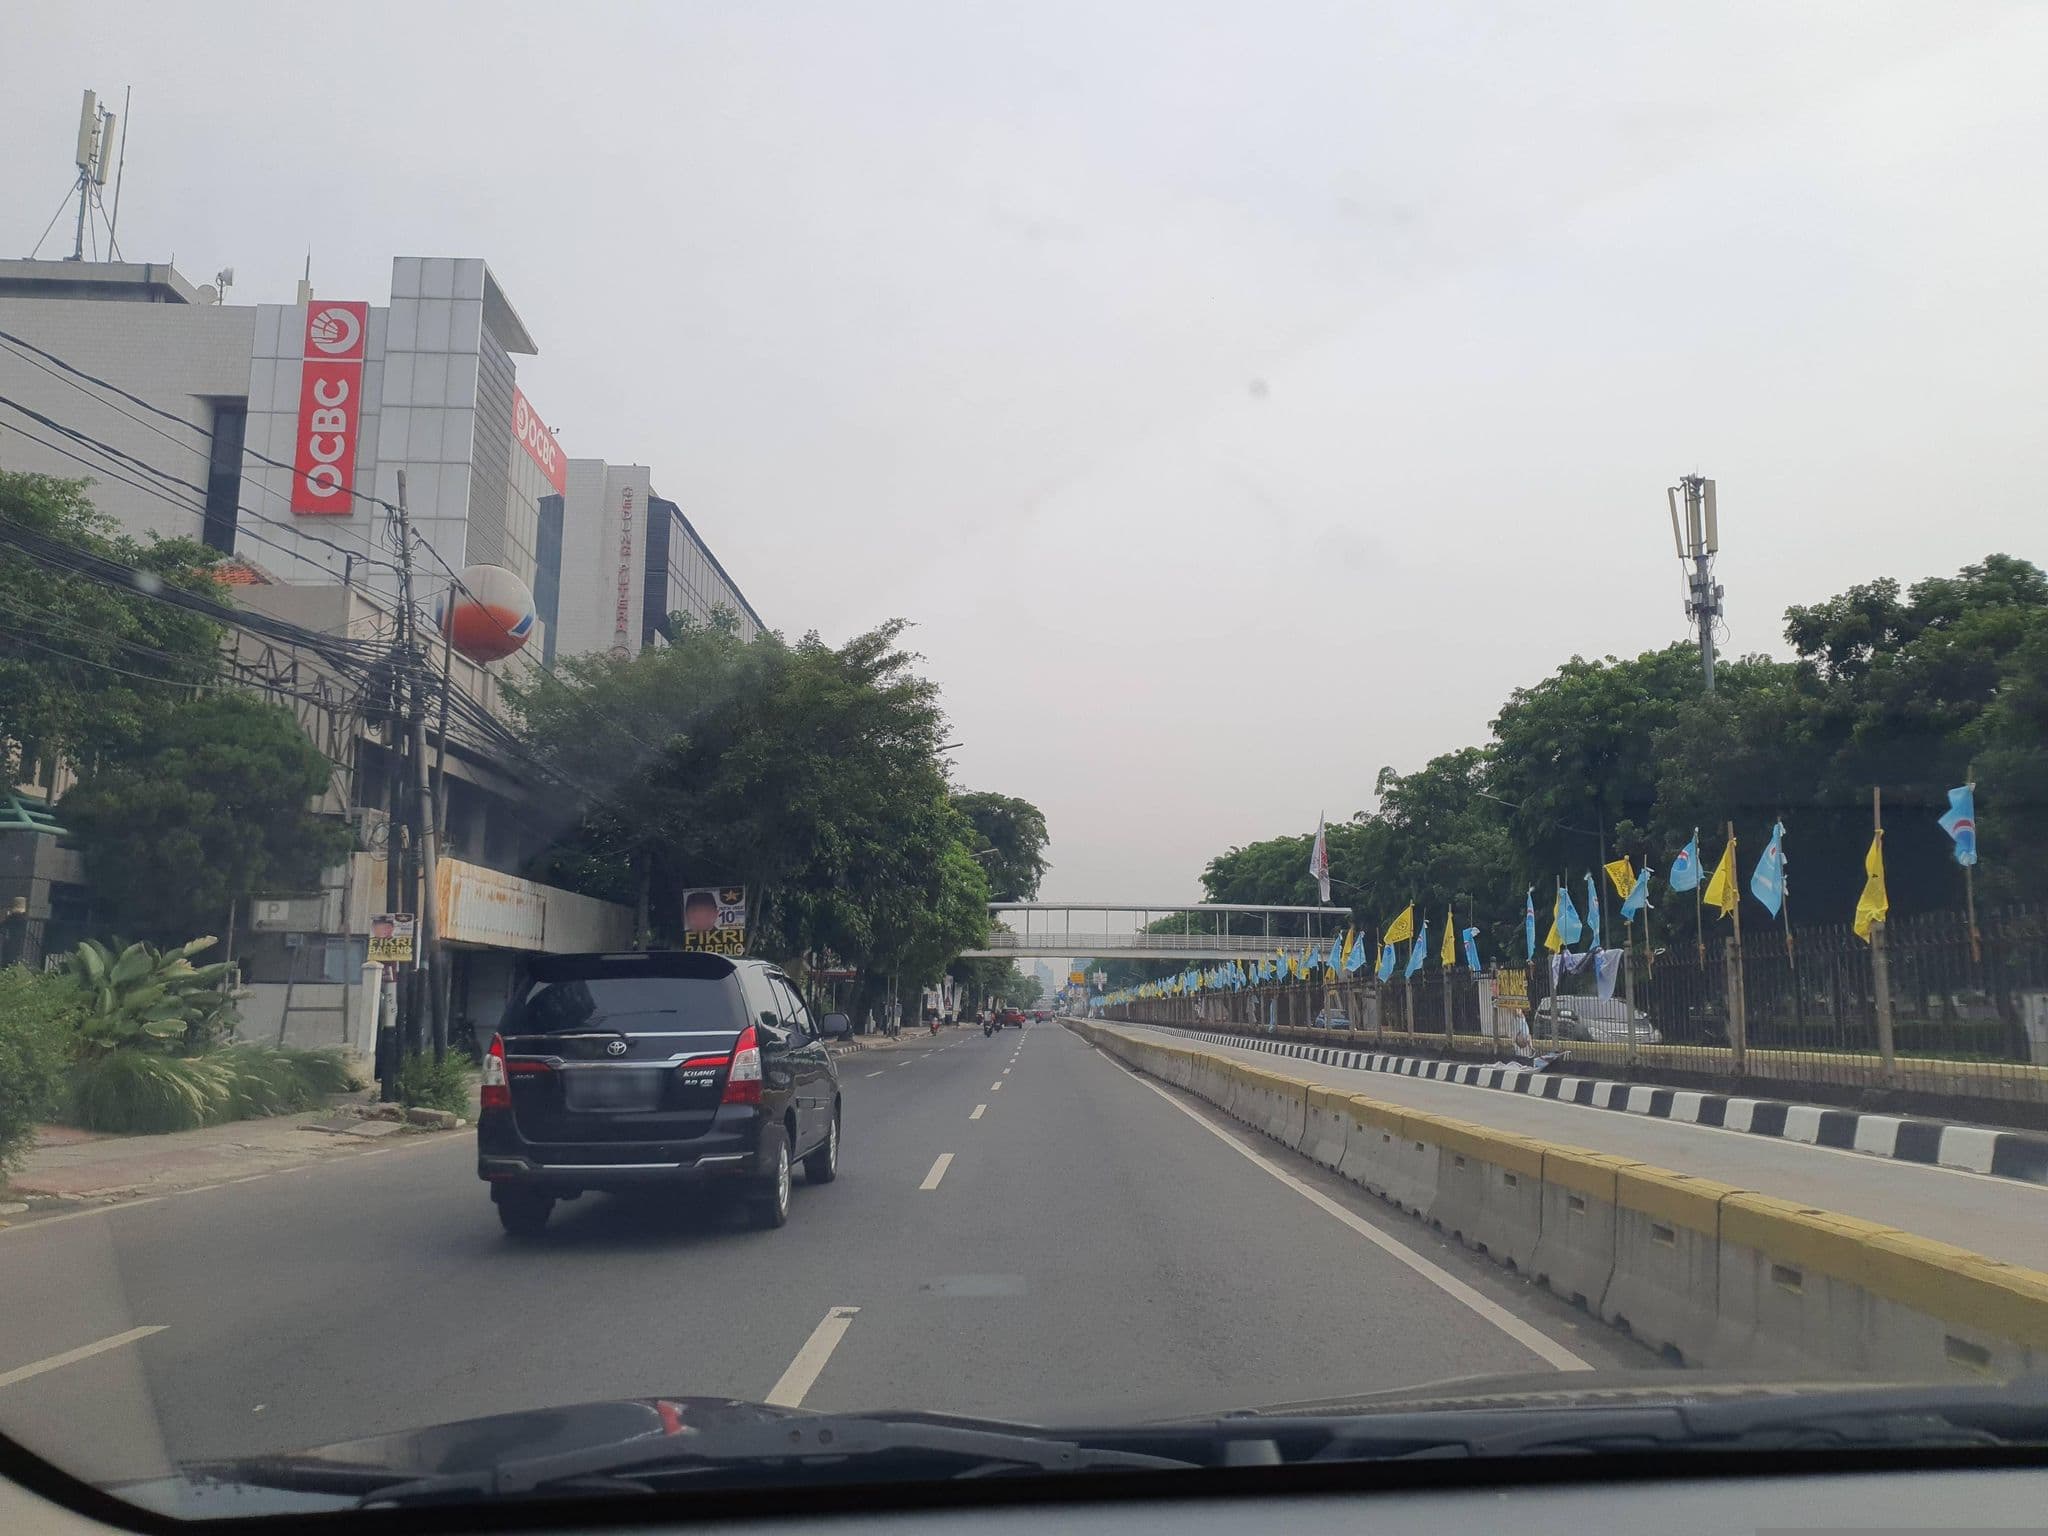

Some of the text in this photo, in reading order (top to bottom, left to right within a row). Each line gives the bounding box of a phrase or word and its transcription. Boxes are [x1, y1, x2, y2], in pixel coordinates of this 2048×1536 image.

[306, 378, 349, 497] OCBC
[528, 417, 556, 473] OCBC
[719, 911, 735, 924] 10
[369, 937, 412, 946] FIKRI
[685, 929, 744, 945] FIKRI
[368, 946, 413, 954] BARENG
